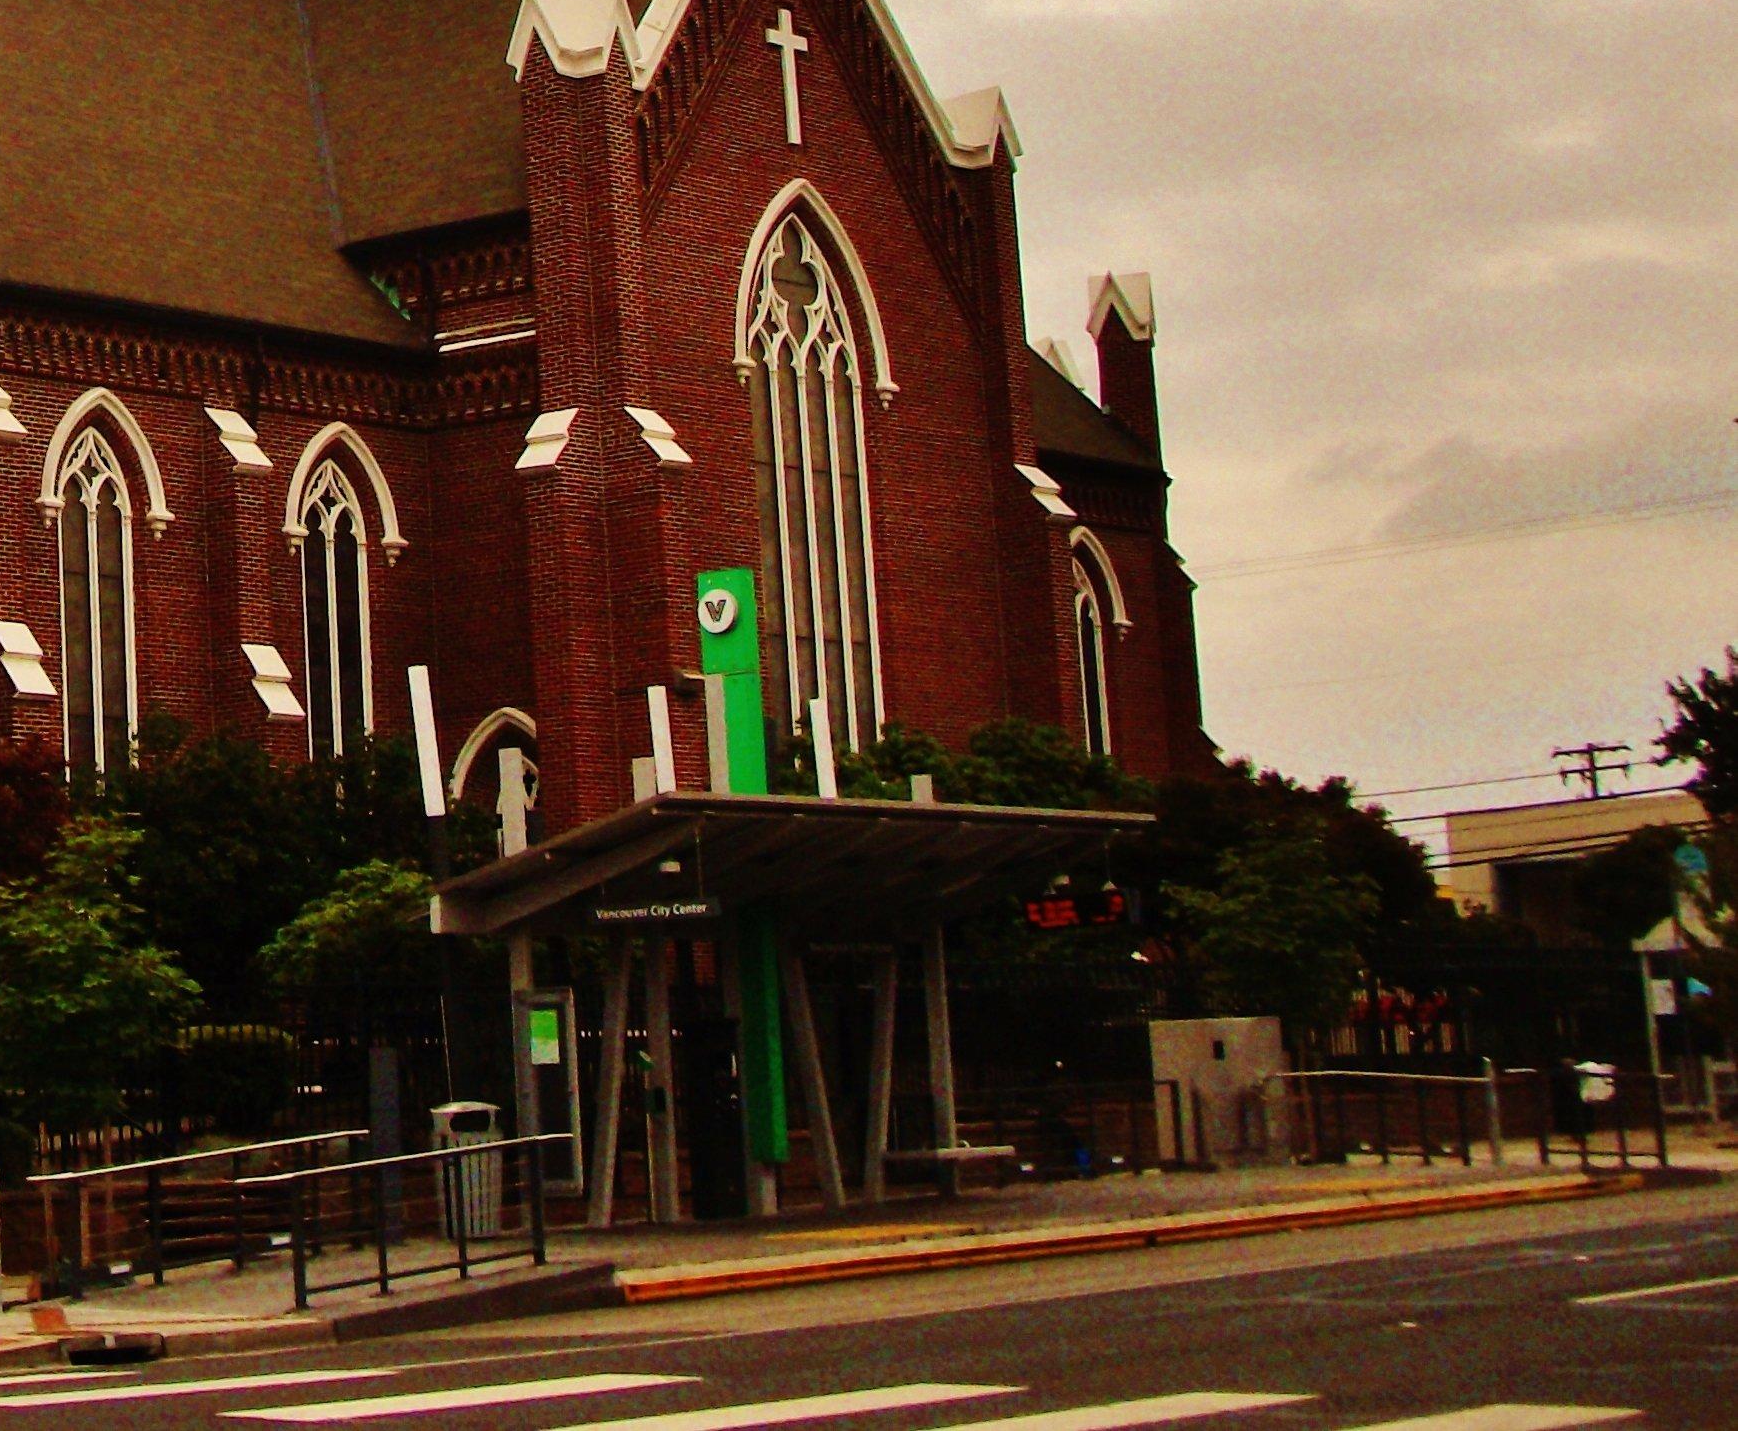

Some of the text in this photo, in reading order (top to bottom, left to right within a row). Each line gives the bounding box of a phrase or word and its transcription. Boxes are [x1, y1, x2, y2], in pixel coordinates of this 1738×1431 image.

[595, 903, 708, 920] Vancouver City Center
